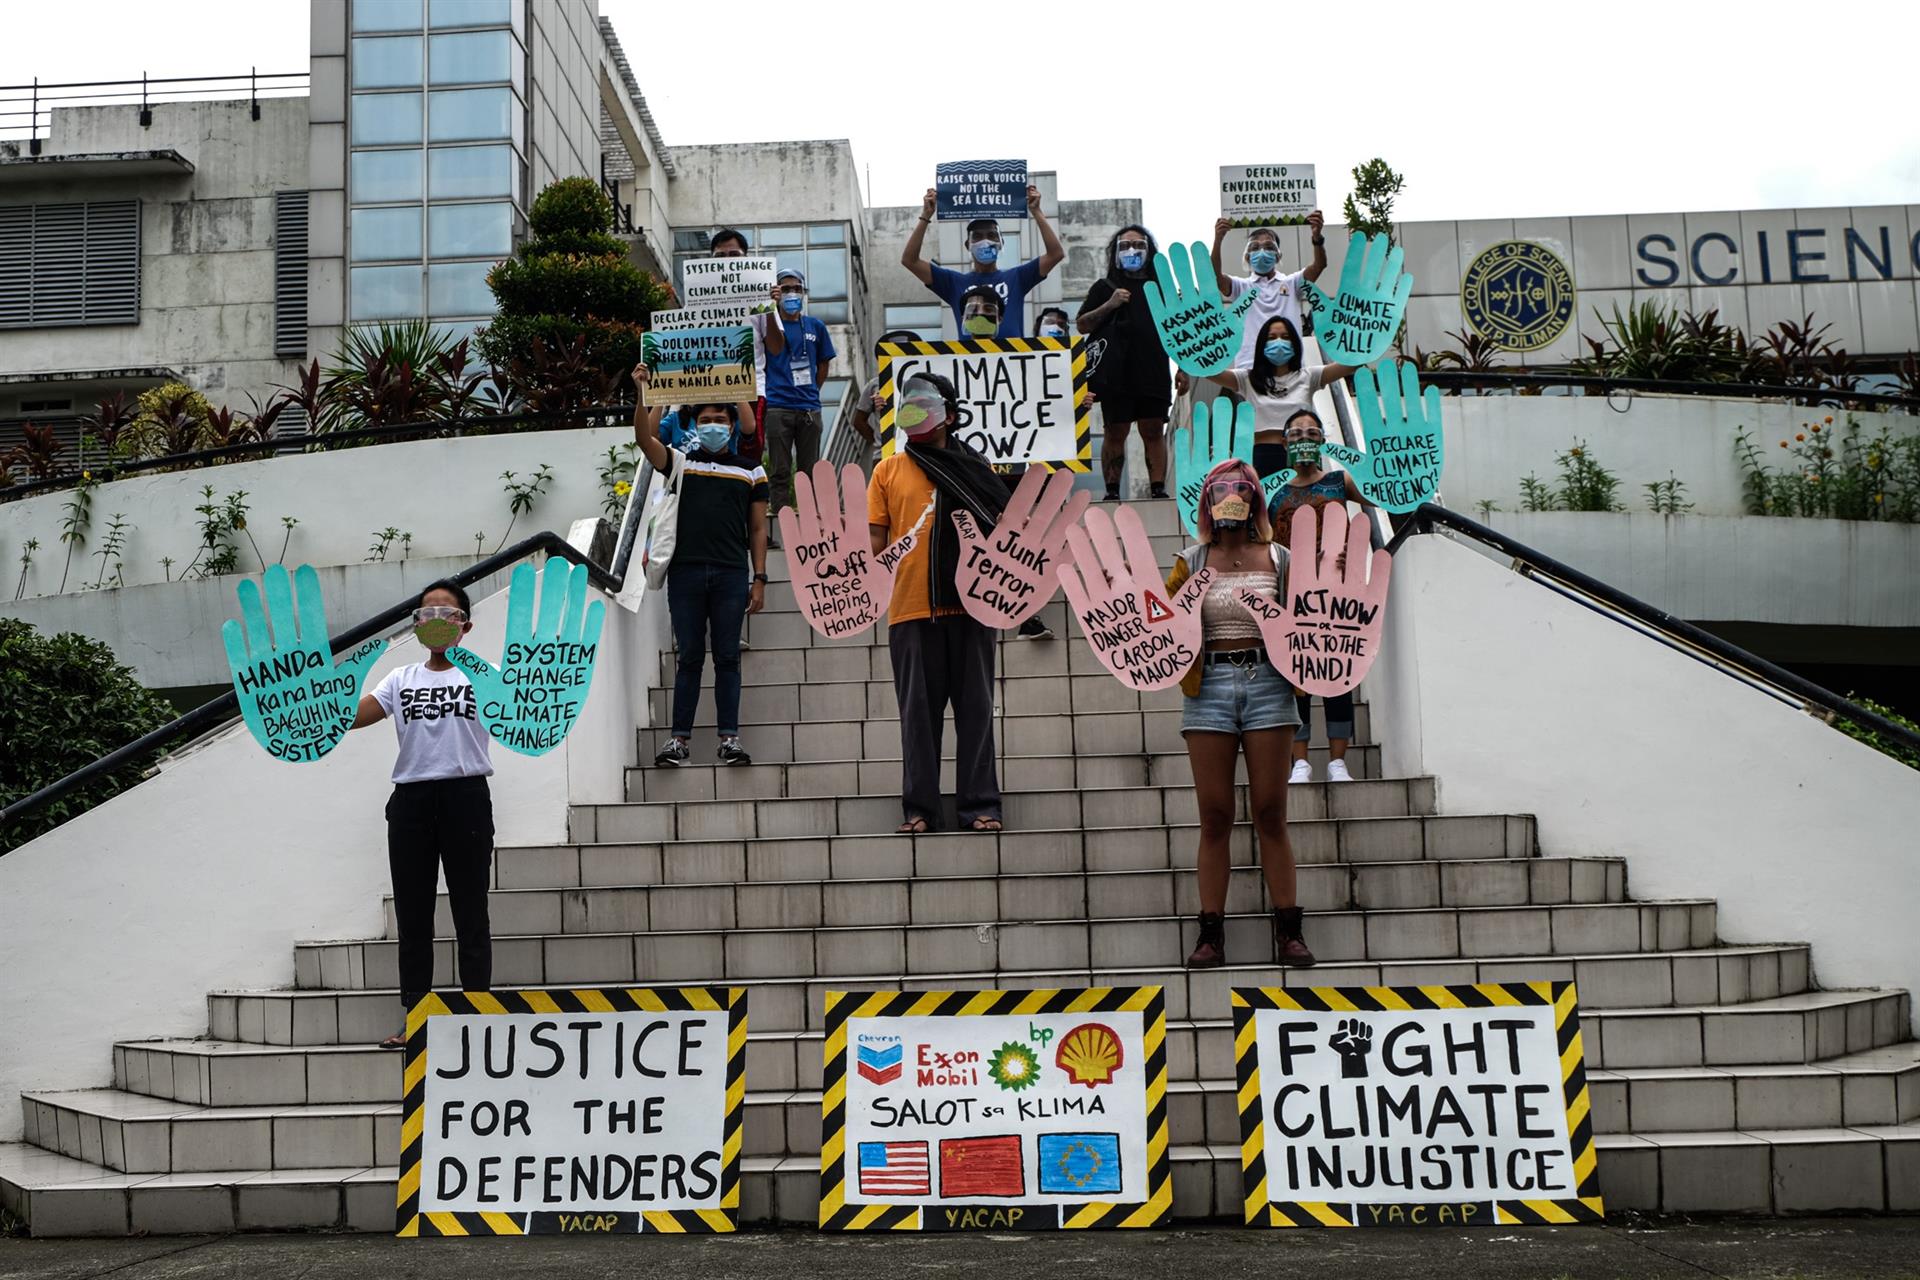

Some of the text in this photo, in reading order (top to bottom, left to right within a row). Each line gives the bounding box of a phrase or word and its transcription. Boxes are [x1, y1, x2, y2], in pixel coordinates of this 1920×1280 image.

[938, 172, 1026, 185] RAISE YOUR VOICES
[1222, 179, 1316, 193] ENVIRONMENTAL
[1246, 167, 1287, 178] DEFEND
[952, 193, 1012, 206] SEA LEVEL!
[960, 183, 1000, 193] NOT THE
[1234, 191, 1302, 205] DEFENDERS!
[685, 261, 772, 275] SYSTEM CHANGE
[1636, 226, 1920, 287] SCIEN
[688, 282, 773, 297] CLIMATE CHANGE!
[721, 273, 742, 284] NOT
[1465, 243, 1572, 310] COLLEGE OF SCIENCE
[1232, 289, 1257, 318] YACAP
[1300, 281, 1325, 312] YACAP
[1339, 293, 1396, 319] CLIMATE
[653, 307, 746, 325] DECLARE CLIMATE
[1161, 301, 1215, 333] KASAMA
[662, 336, 732, 350] DOLOMITES,
[1176, 326, 1235, 360] MAGAGAWA
[1336, 328, 1373, 354] ALL!
[1508, 316, 1566, 348] DILIMAN
[683, 363, 714, 375] NOW?
[696, 349, 718, 361] ARE
[1193, 343, 1230, 369] TAYO!
[647, 378, 674, 390] SAVE
[678, 375, 721, 388] MANILA
[957, 400, 1056, 430] STICE
[955, 428, 1039, 459] OW!
[1325, 443, 1361, 466] YACAP
[1370, 433, 1437, 457] DECLARE
[1373, 449, 1440, 479] CLIMATE
[1263, 470, 1291, 496] ACAP
[1363, 468, 1439, 507] EMERGENCY!
[795, 531, 840, 567] Don't
[876, 535, 913, 575] YACAP
[996, 530, 1051, 577] Junk
[967, 545, 1035, 599] Terror
[805, 577, 863, 601] These
[967, 576, 1029, 620] Law!
[1177, 568, 1212, 615] YACAP
[810, 591, 872, 619] Helping
[1082, 592, 1141, 631] MAJOR
[1238, 588, 1281, 621] YACAP
[1294, 589, 1379, 626] ACT NOW
[823, 601, 879, 637] Hands!
[1091, 617, 1152, 652] DANGER
[1284, 631, 1368, 657] TALK TO THE
[344, 639, 382, 665] YACAP
[506, 642, 597, 666] SYSTEM
[1111, 628, 1175, 670] CARBON
[502, 667, 587, 687] CHANGE
[1129, 644, 1194, 686] MAJORS
[1292, 653, 1353, 686] HAND!
[283, 686, 307, 707] na
[310, 673, 356, 700] bang
[400, 684, 476, 707] SERVE
[513, 687, 566, 704] NOT
[263, 697, 342, 738] BAGUHIN
[482, 701, 578, 723] CLIMATE
[266, 705, 356, 763] SISTEMA?
[290, 723, 324, 741] ang
[489, 720, 570, 750] CHANGE!
[857, 1033, 902, 1044] Chevron
[1029, 1021, 1054, 1049] bp
[436, 1019, 707, 1080] JUSTICE
[916, 1068, 979, 1088] Mobil
[441, 1096, 665, 1139] FOR THE
[870, 1094, 1106, 1128] SALOT sa KLIMA
[1273, 1083, 1556, 1140] CLIMATE
[436, 1150, 722, 1203] DEFENDERS
[1286, 1144, 1567, 1191] INJUSTICE
[558, 1214, 619, 1232] YACAP
[944, 1208, 1024, 1228] YACAP
[1368, 1204, 1478, 1224] YACAP
